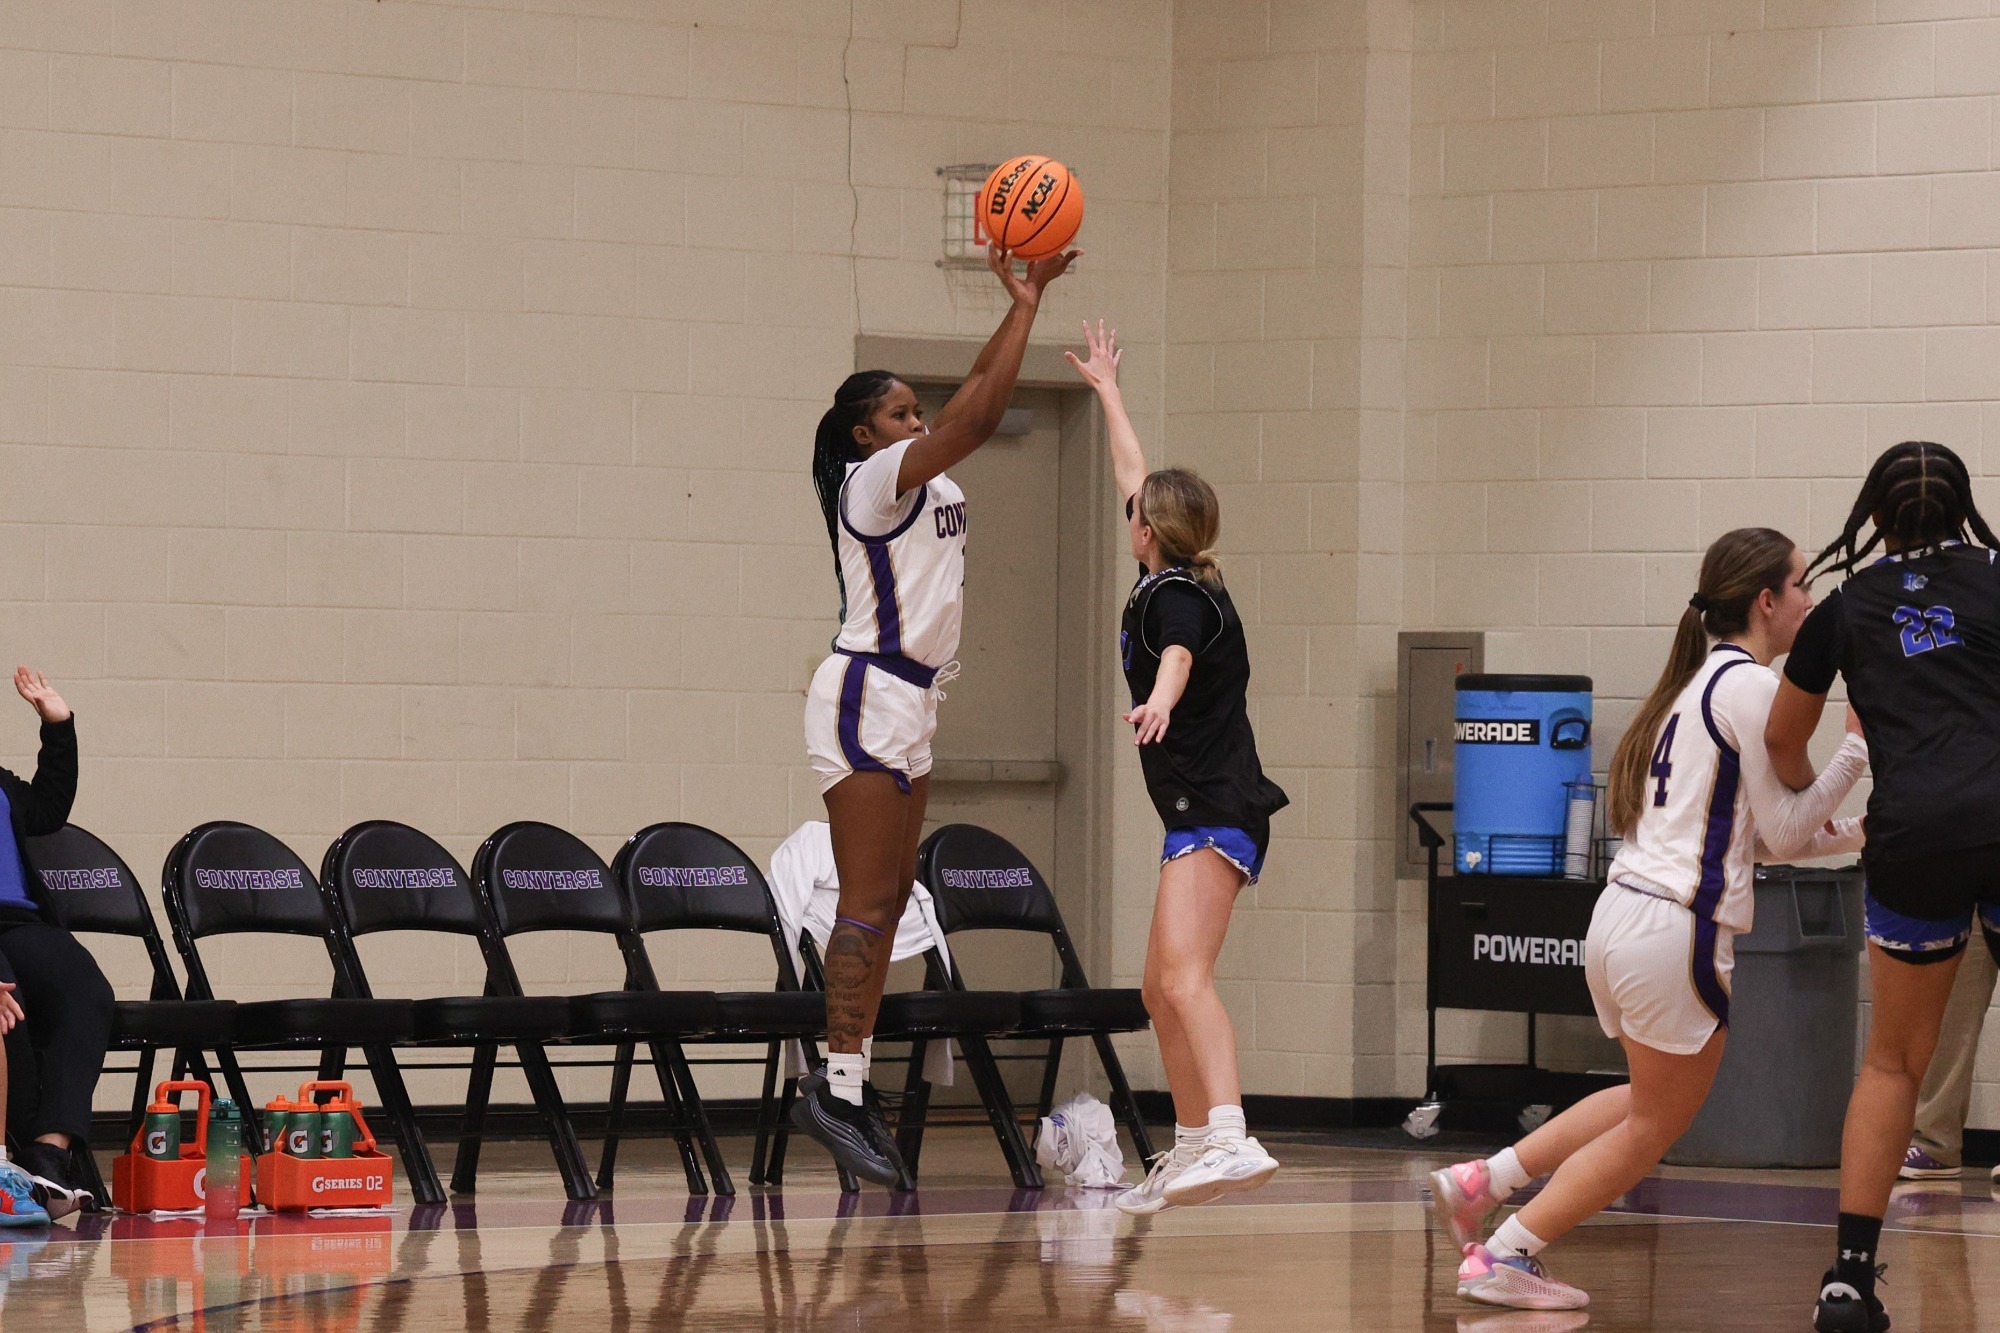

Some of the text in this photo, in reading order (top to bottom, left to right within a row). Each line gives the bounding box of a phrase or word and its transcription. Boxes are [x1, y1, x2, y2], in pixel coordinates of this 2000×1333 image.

[1021, 173, 1058, 222] NCAA
[1892, 605, 1965, 658] 22
[1453, 721, 1532, 742] WERADE
[1650, 711, 1682, 808] 4
[196, 868, 304, 890] CONVERSE
[352, 867, 457, 889] CONVERSE
[502, 868, 603, 890] CONVERSE
[638, 865, 748, 887] CONVERSE
[941, 867, 1033, 889] CONVERSE
[147, 1130, 167, 1155] G
[289, 1129, 309, 1154] G
[366, 1175, 384, 1191] 02
